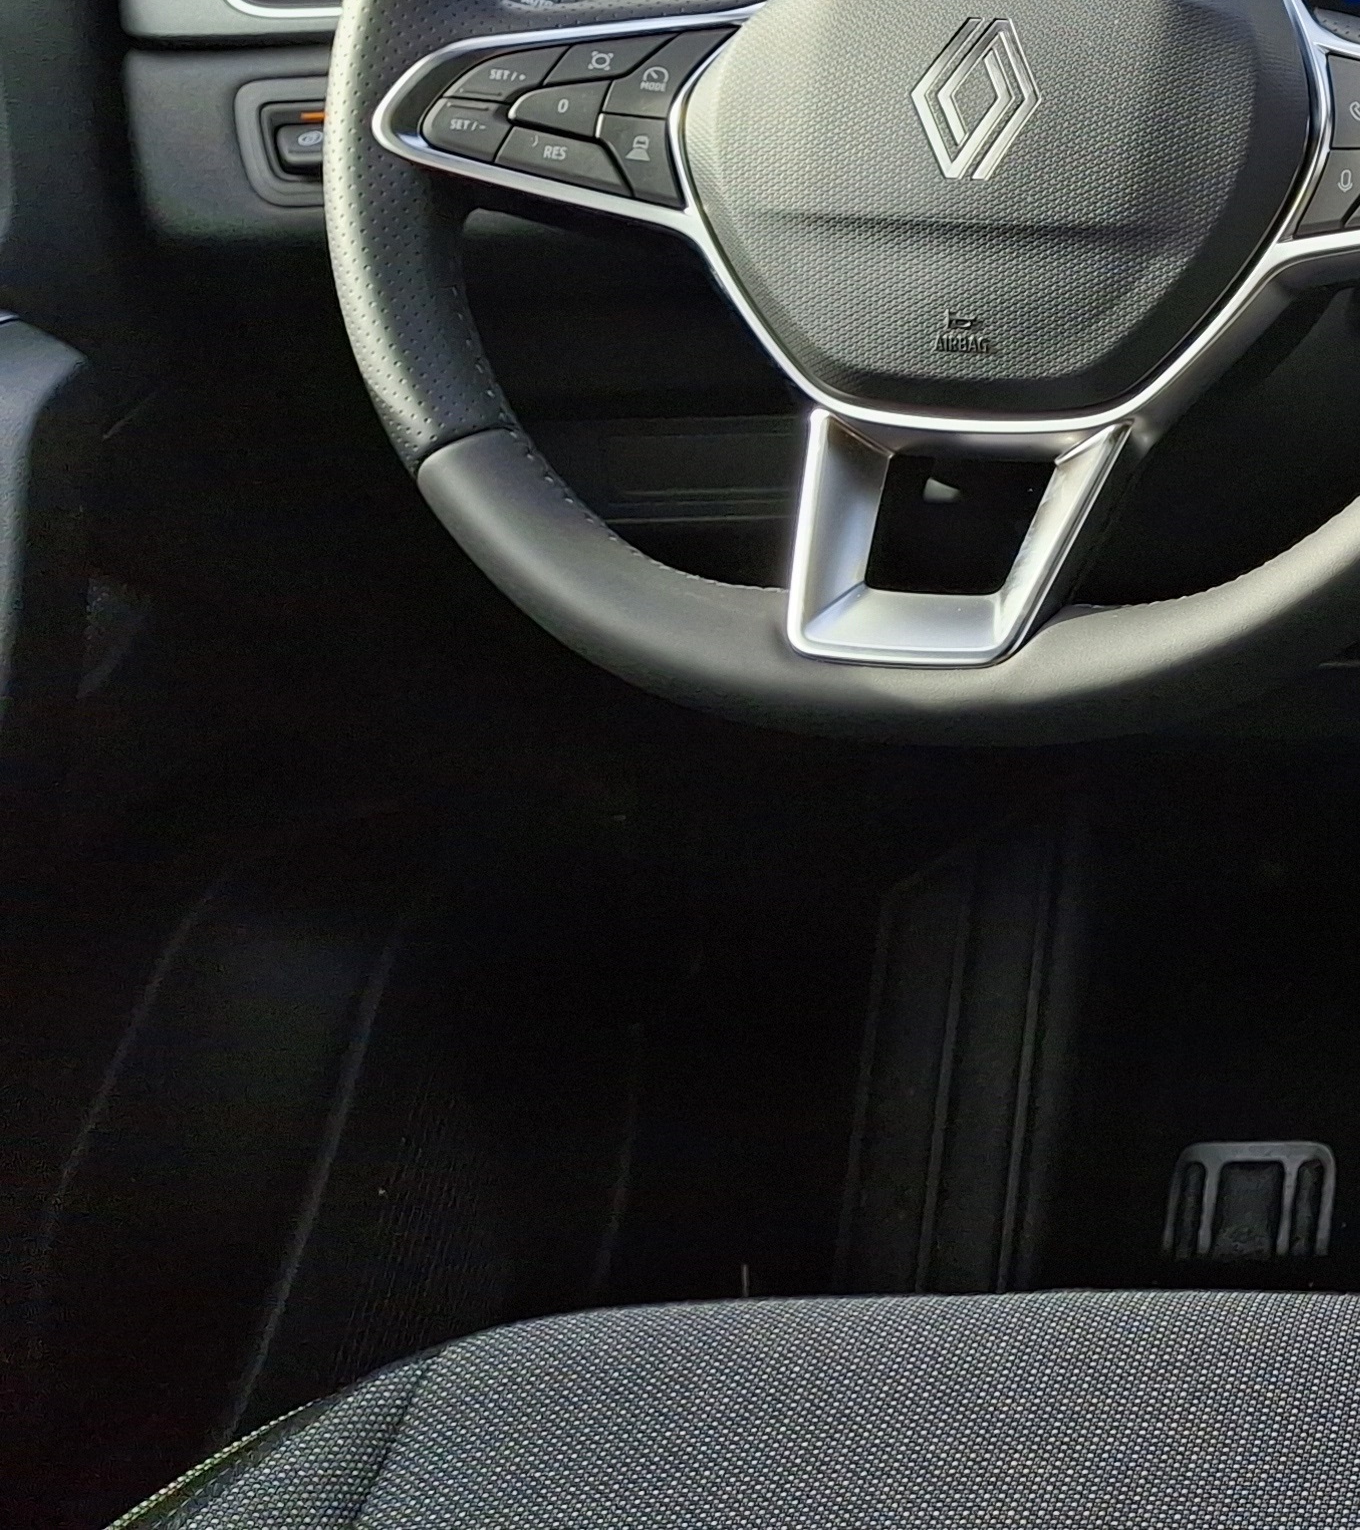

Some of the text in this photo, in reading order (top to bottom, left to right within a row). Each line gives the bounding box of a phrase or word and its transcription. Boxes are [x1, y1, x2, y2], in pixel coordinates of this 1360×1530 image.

[640, 79, 666, 92] MODE
[543, 145, 568, 161] RES
[934, 334, 990, 354] AIRBAG
